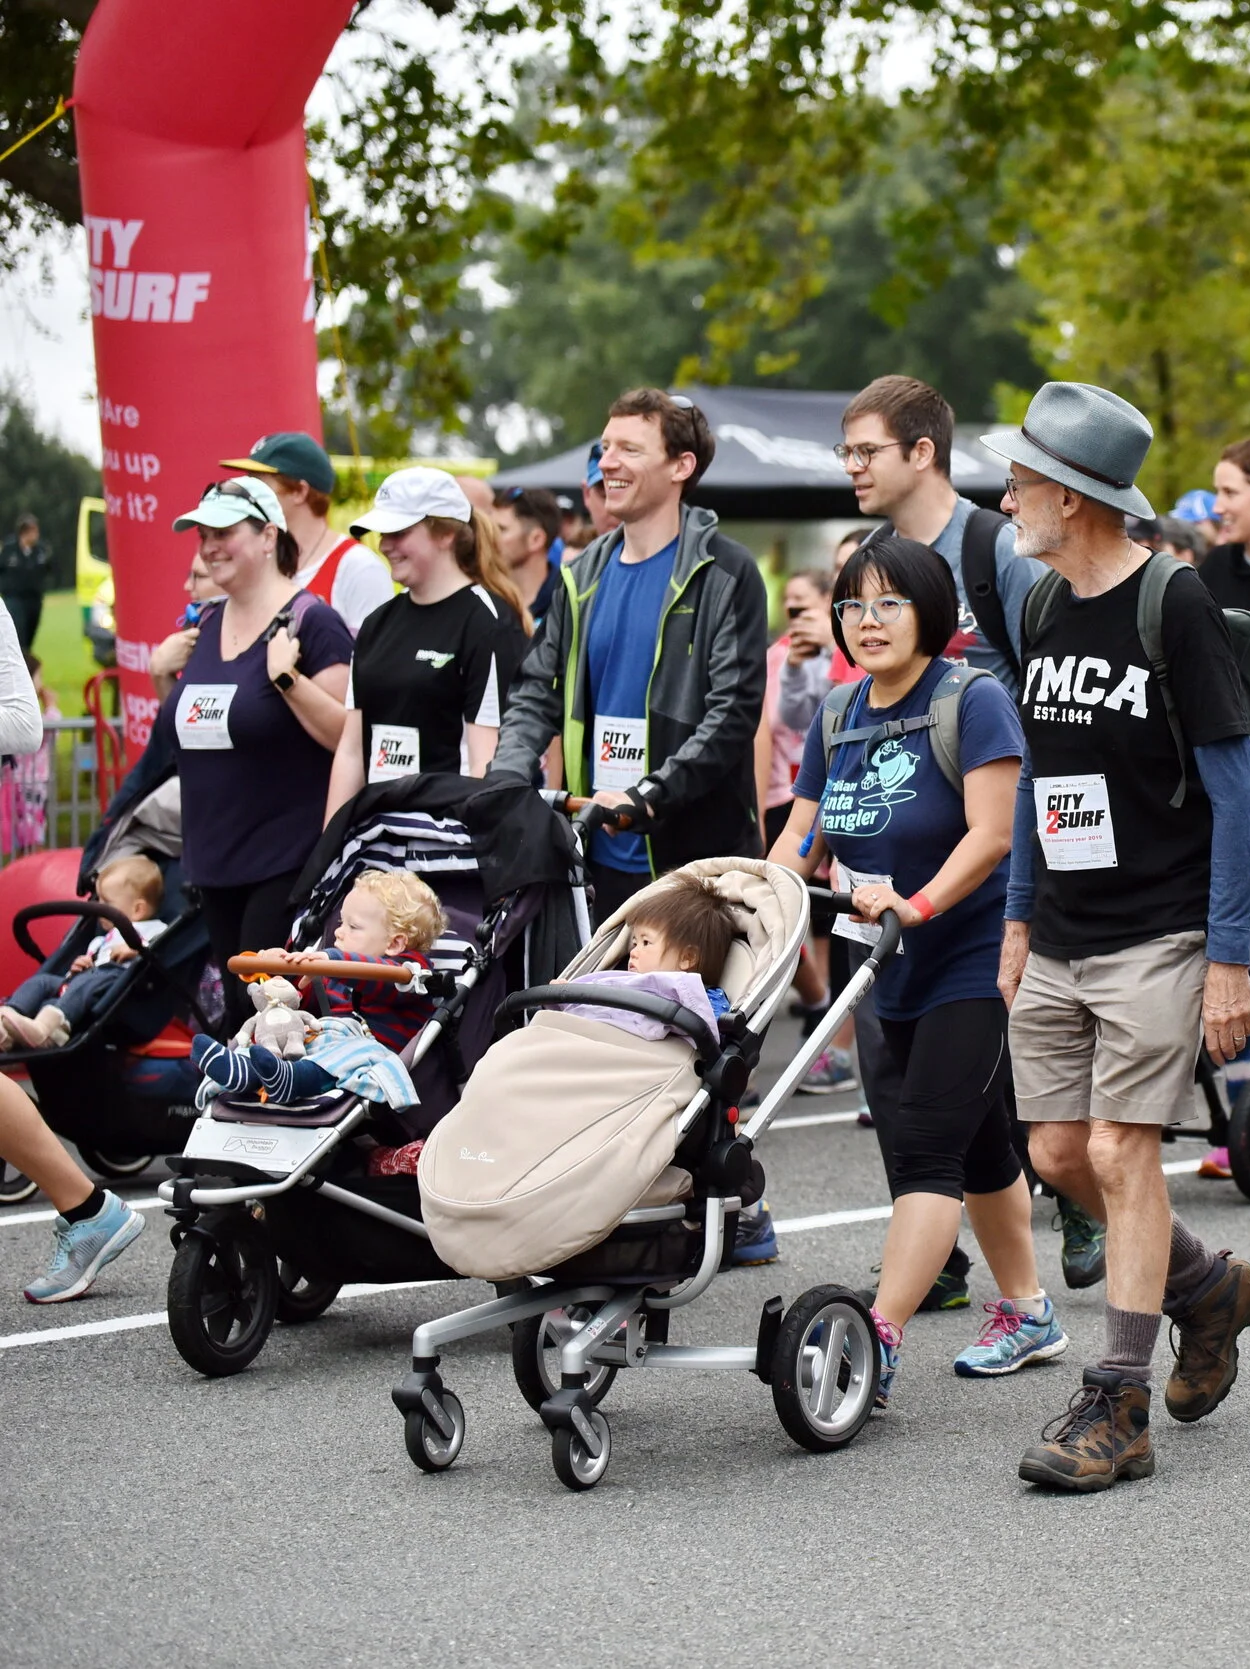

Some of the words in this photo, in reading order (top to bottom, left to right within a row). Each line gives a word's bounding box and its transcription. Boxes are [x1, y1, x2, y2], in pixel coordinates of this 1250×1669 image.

[124, 452, 160, 482] up
[126, 491, 158, 522] it?
[1022, 655, 1150, 719] YMCA
[192, 697, 217, 709] CITY
[1033, 705, 1093, 725] EST.1844
[380, 738, 403, 752] CITY
[602, 730, 631, 746] CITY
[1047, 793, 1085, 812] CITY
[821, 809, 880, 832] rangler
